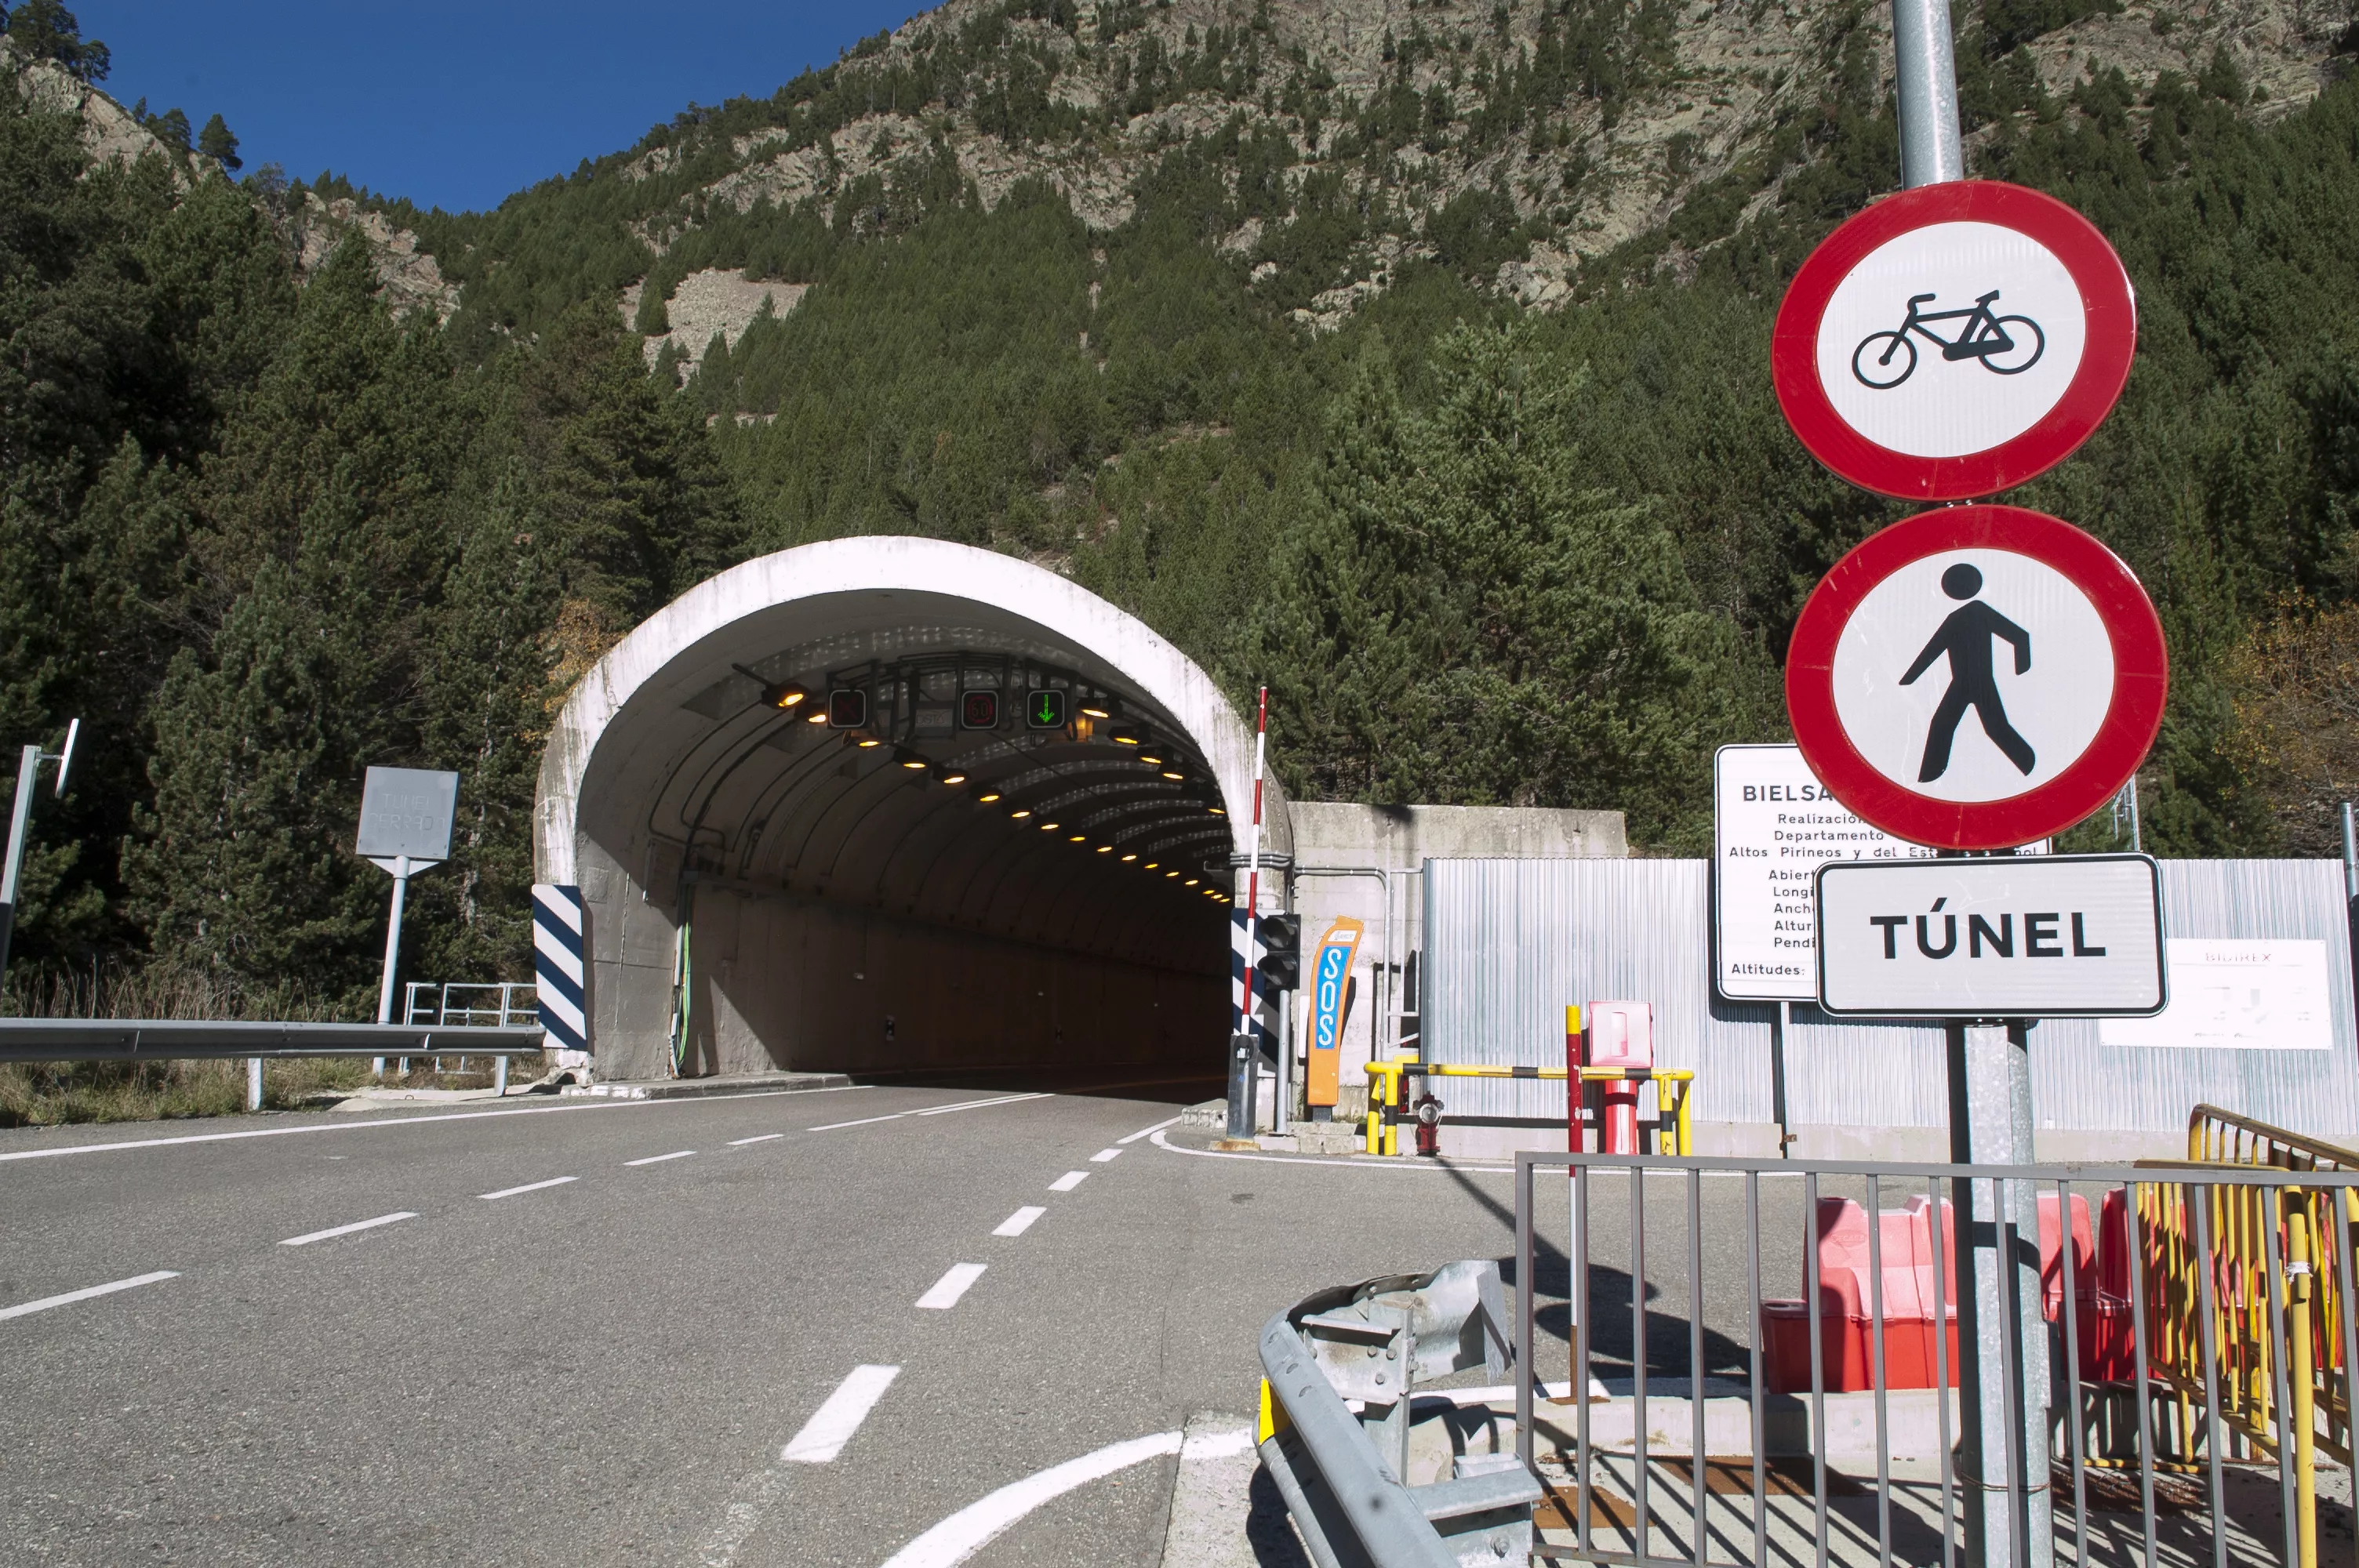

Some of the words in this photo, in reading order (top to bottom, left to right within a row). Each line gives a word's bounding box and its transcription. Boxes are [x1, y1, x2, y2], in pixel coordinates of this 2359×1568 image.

[1743, 785, 1834, 801] BIELSA
[1774, 830, 1884, 843] Departamento
[1729, 847, 1768, 858] Altos
[1853, 849, 1861, 860] y
[1873, 847, 1897, 858] del
[1773, 903, 1813, 913] Anch
[1870, 897, 2106, 960] TÚNEL
[1318, 948, 1342, 1046] SOS
